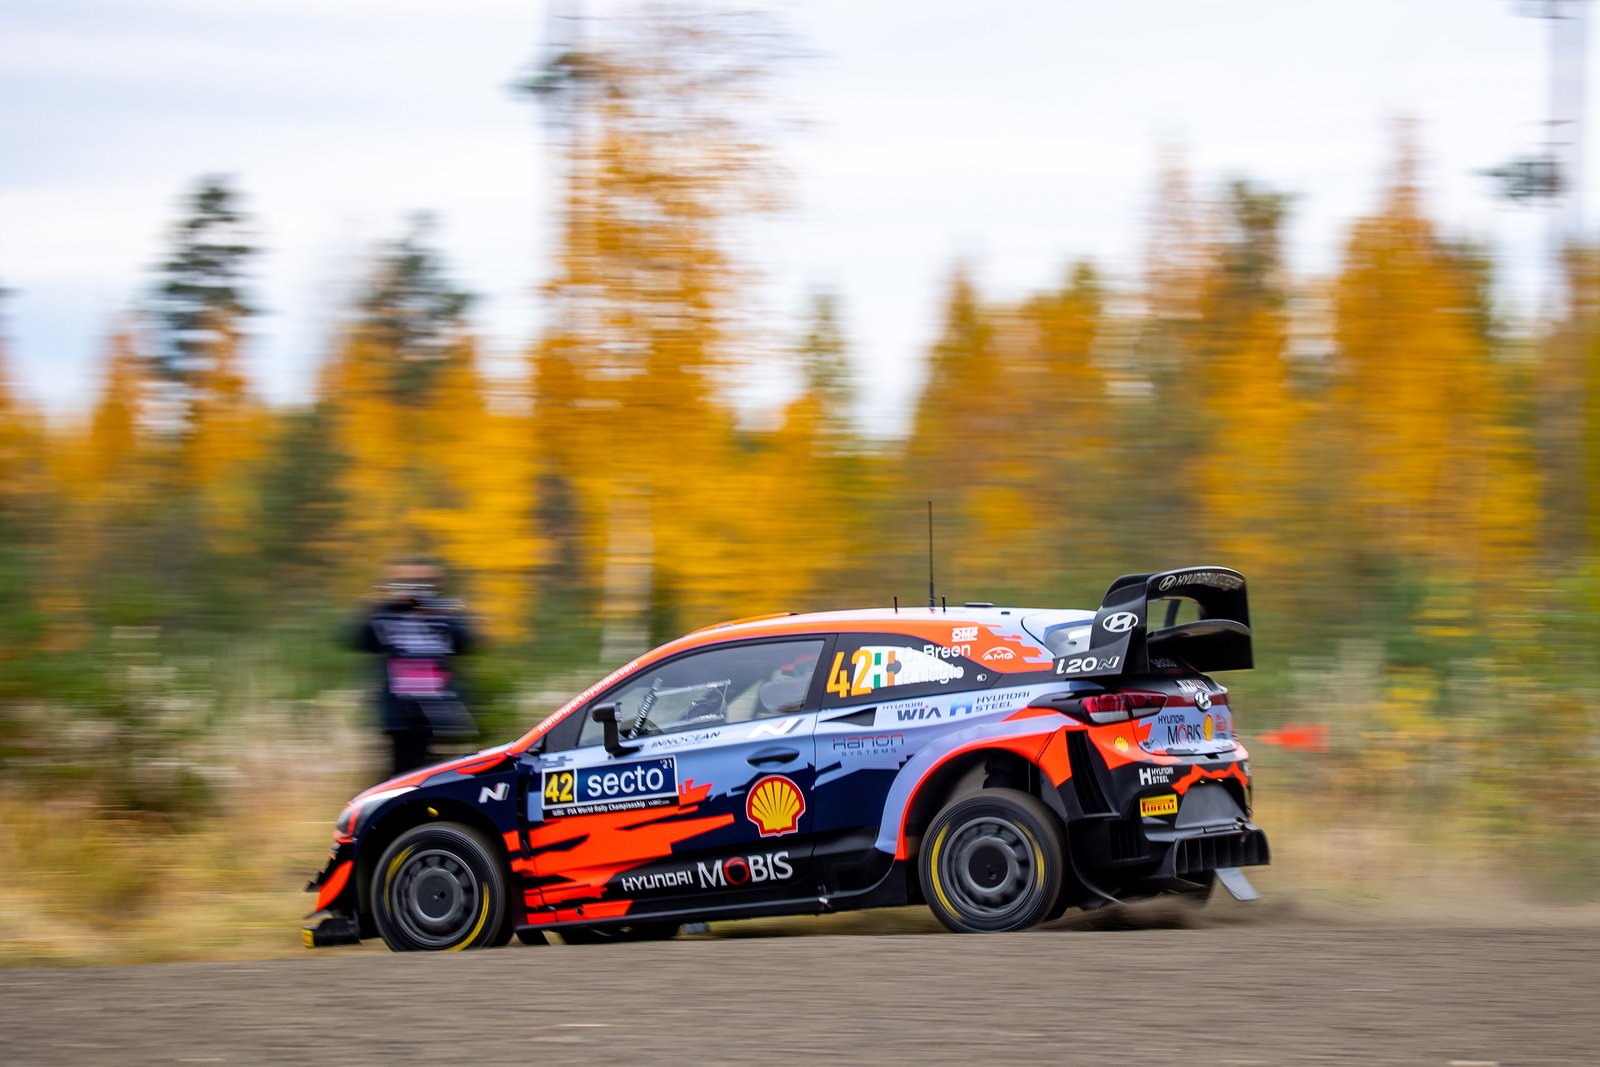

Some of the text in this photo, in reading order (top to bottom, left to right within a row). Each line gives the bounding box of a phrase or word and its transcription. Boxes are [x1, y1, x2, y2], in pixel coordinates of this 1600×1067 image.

[923, 644, 971, 659] Breen
[826, 649, 872, 698] 42
[976, 691, 1030, 704] HYUNDAI
[881, 701, 924, 711] HYUNDAI
[975, 702, 1014, 713] STEEL
[1157, 715, 1185, 724] HYUNDAI
[1167, 724, 1202, 745] MOBIS
[841, 748, 897, 758] SYSTEMS
[1151, 767, 1174, 776] HYUNDAI
[587, 765, 664, 797] secto
[1152, 775, 1170, 784] STEEL
[545, 773, 574, 803] 42
[621, 851, 793, 892] HYUNDAI MOBIS
